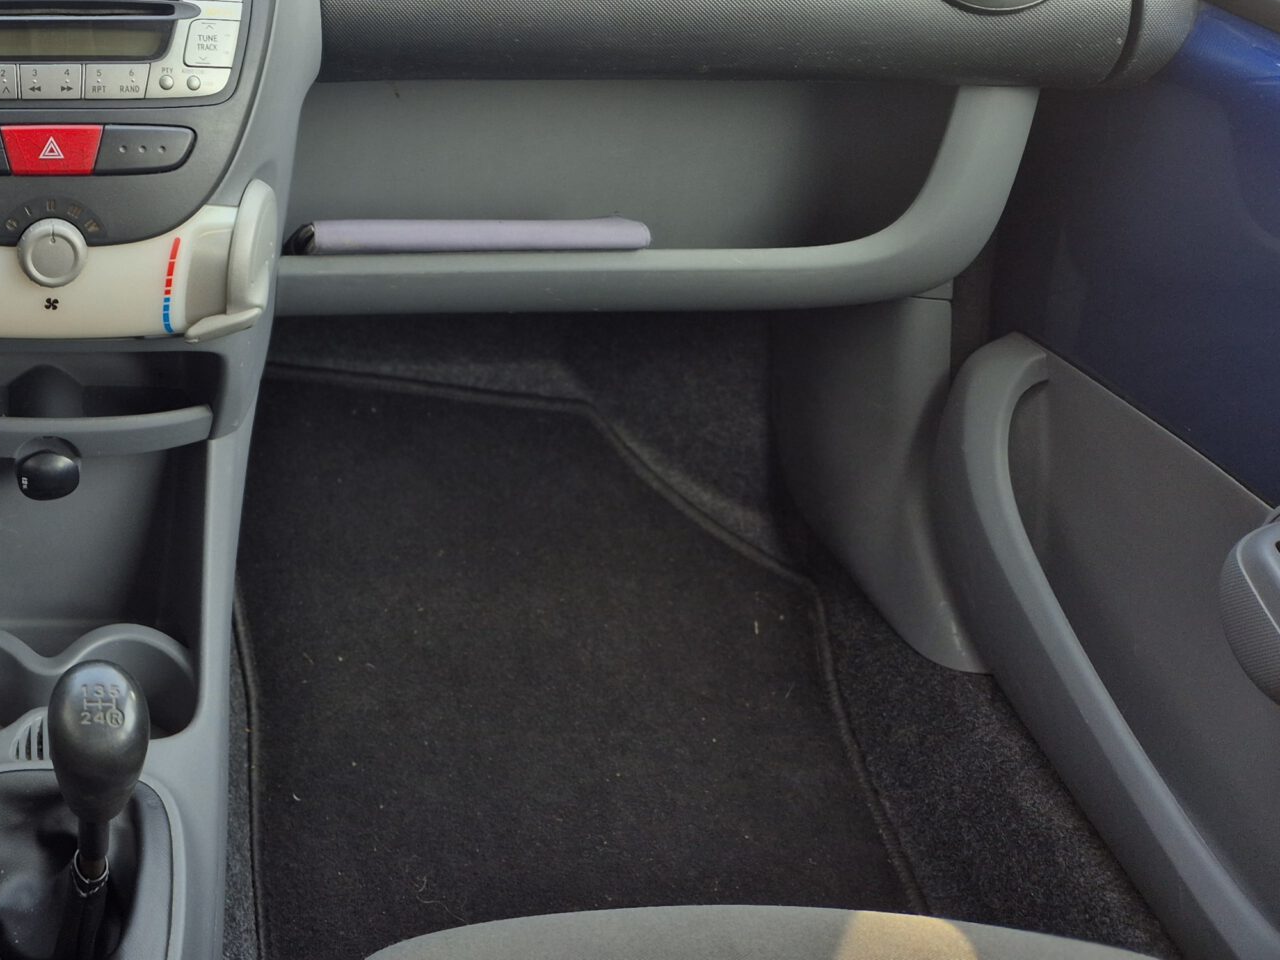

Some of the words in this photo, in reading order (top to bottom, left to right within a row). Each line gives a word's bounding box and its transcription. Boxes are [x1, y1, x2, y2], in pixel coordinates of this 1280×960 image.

[197, 34, 218, 42] TUNE
[197, 43, 218, 51] TRACK
[1, 69, 6, 77] 2
[32, 69, 38, 77] 3
[120, 85, 140, 93] RAND
[81, 684, 88, 697] 1
[94, 684, 105, 697] 3
[108, 684, 120, 698] 5
[81, 711, 91, 725] 2
[93, 712, 105, 724] 4
